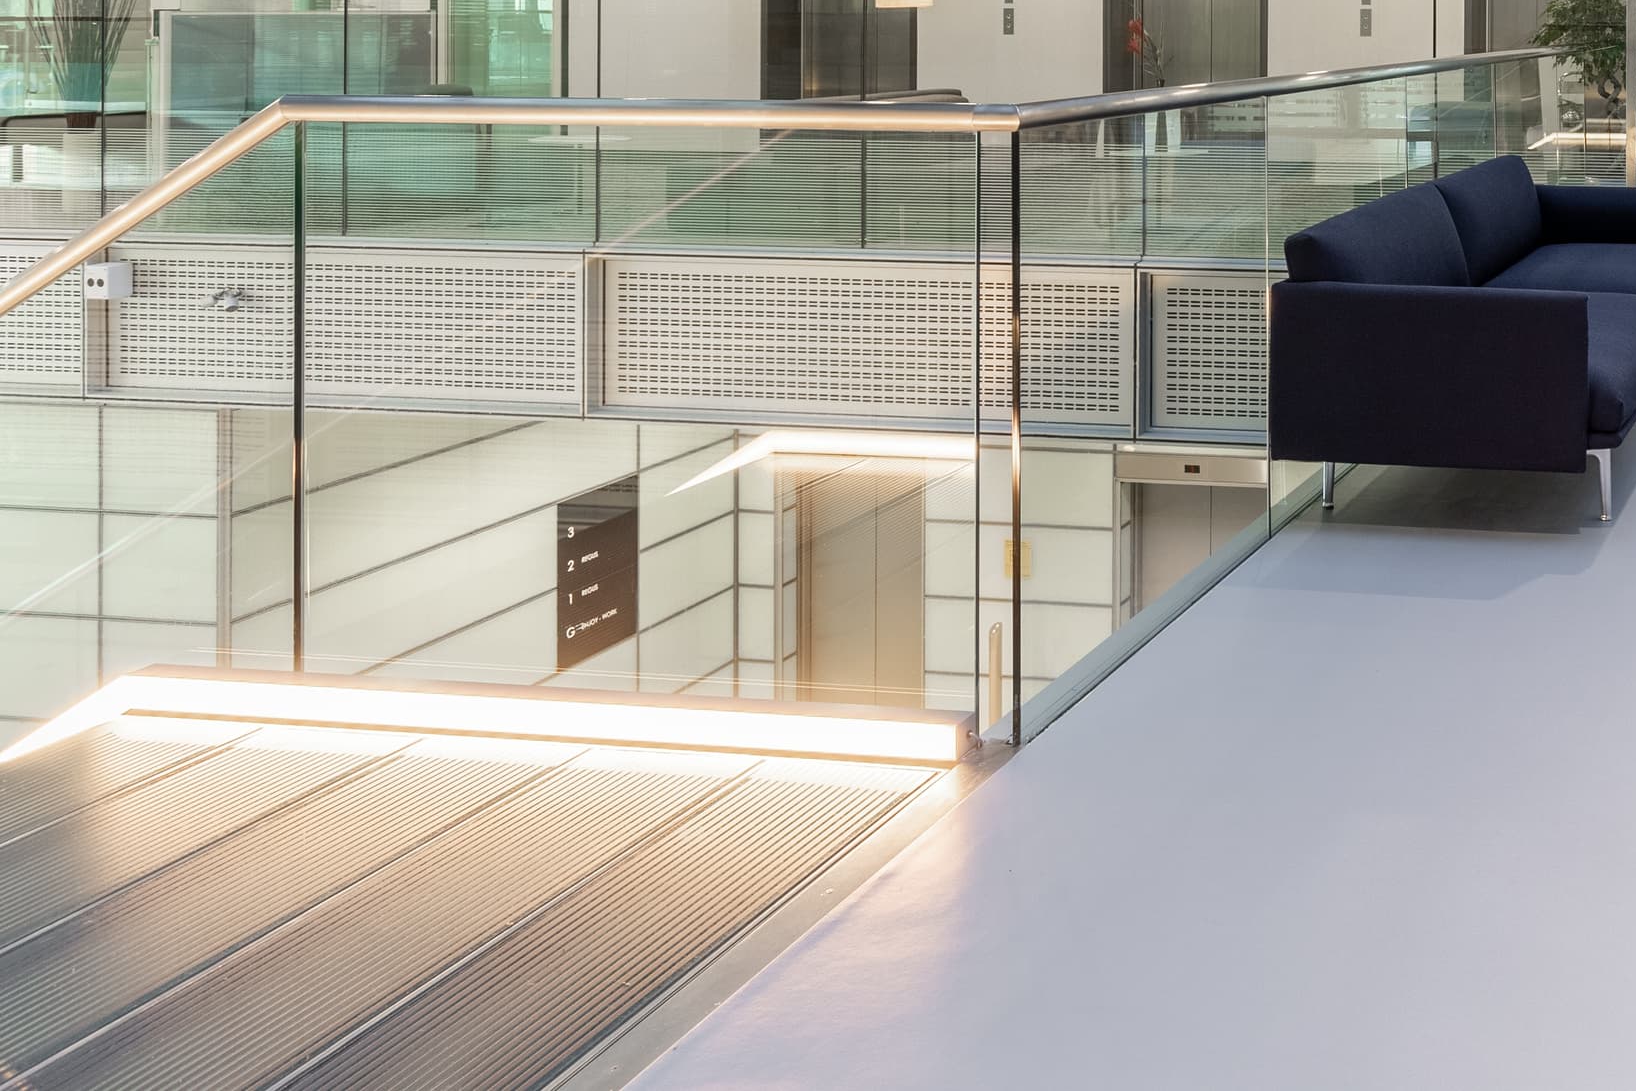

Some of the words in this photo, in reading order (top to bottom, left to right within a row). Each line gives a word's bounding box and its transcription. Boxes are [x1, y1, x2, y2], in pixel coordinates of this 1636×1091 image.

[567, 526, 574, 538] 3
[567, 560, 575, 572] 2
[568, 593, 573, 605] 1
[566, 627, 576, 639] G
